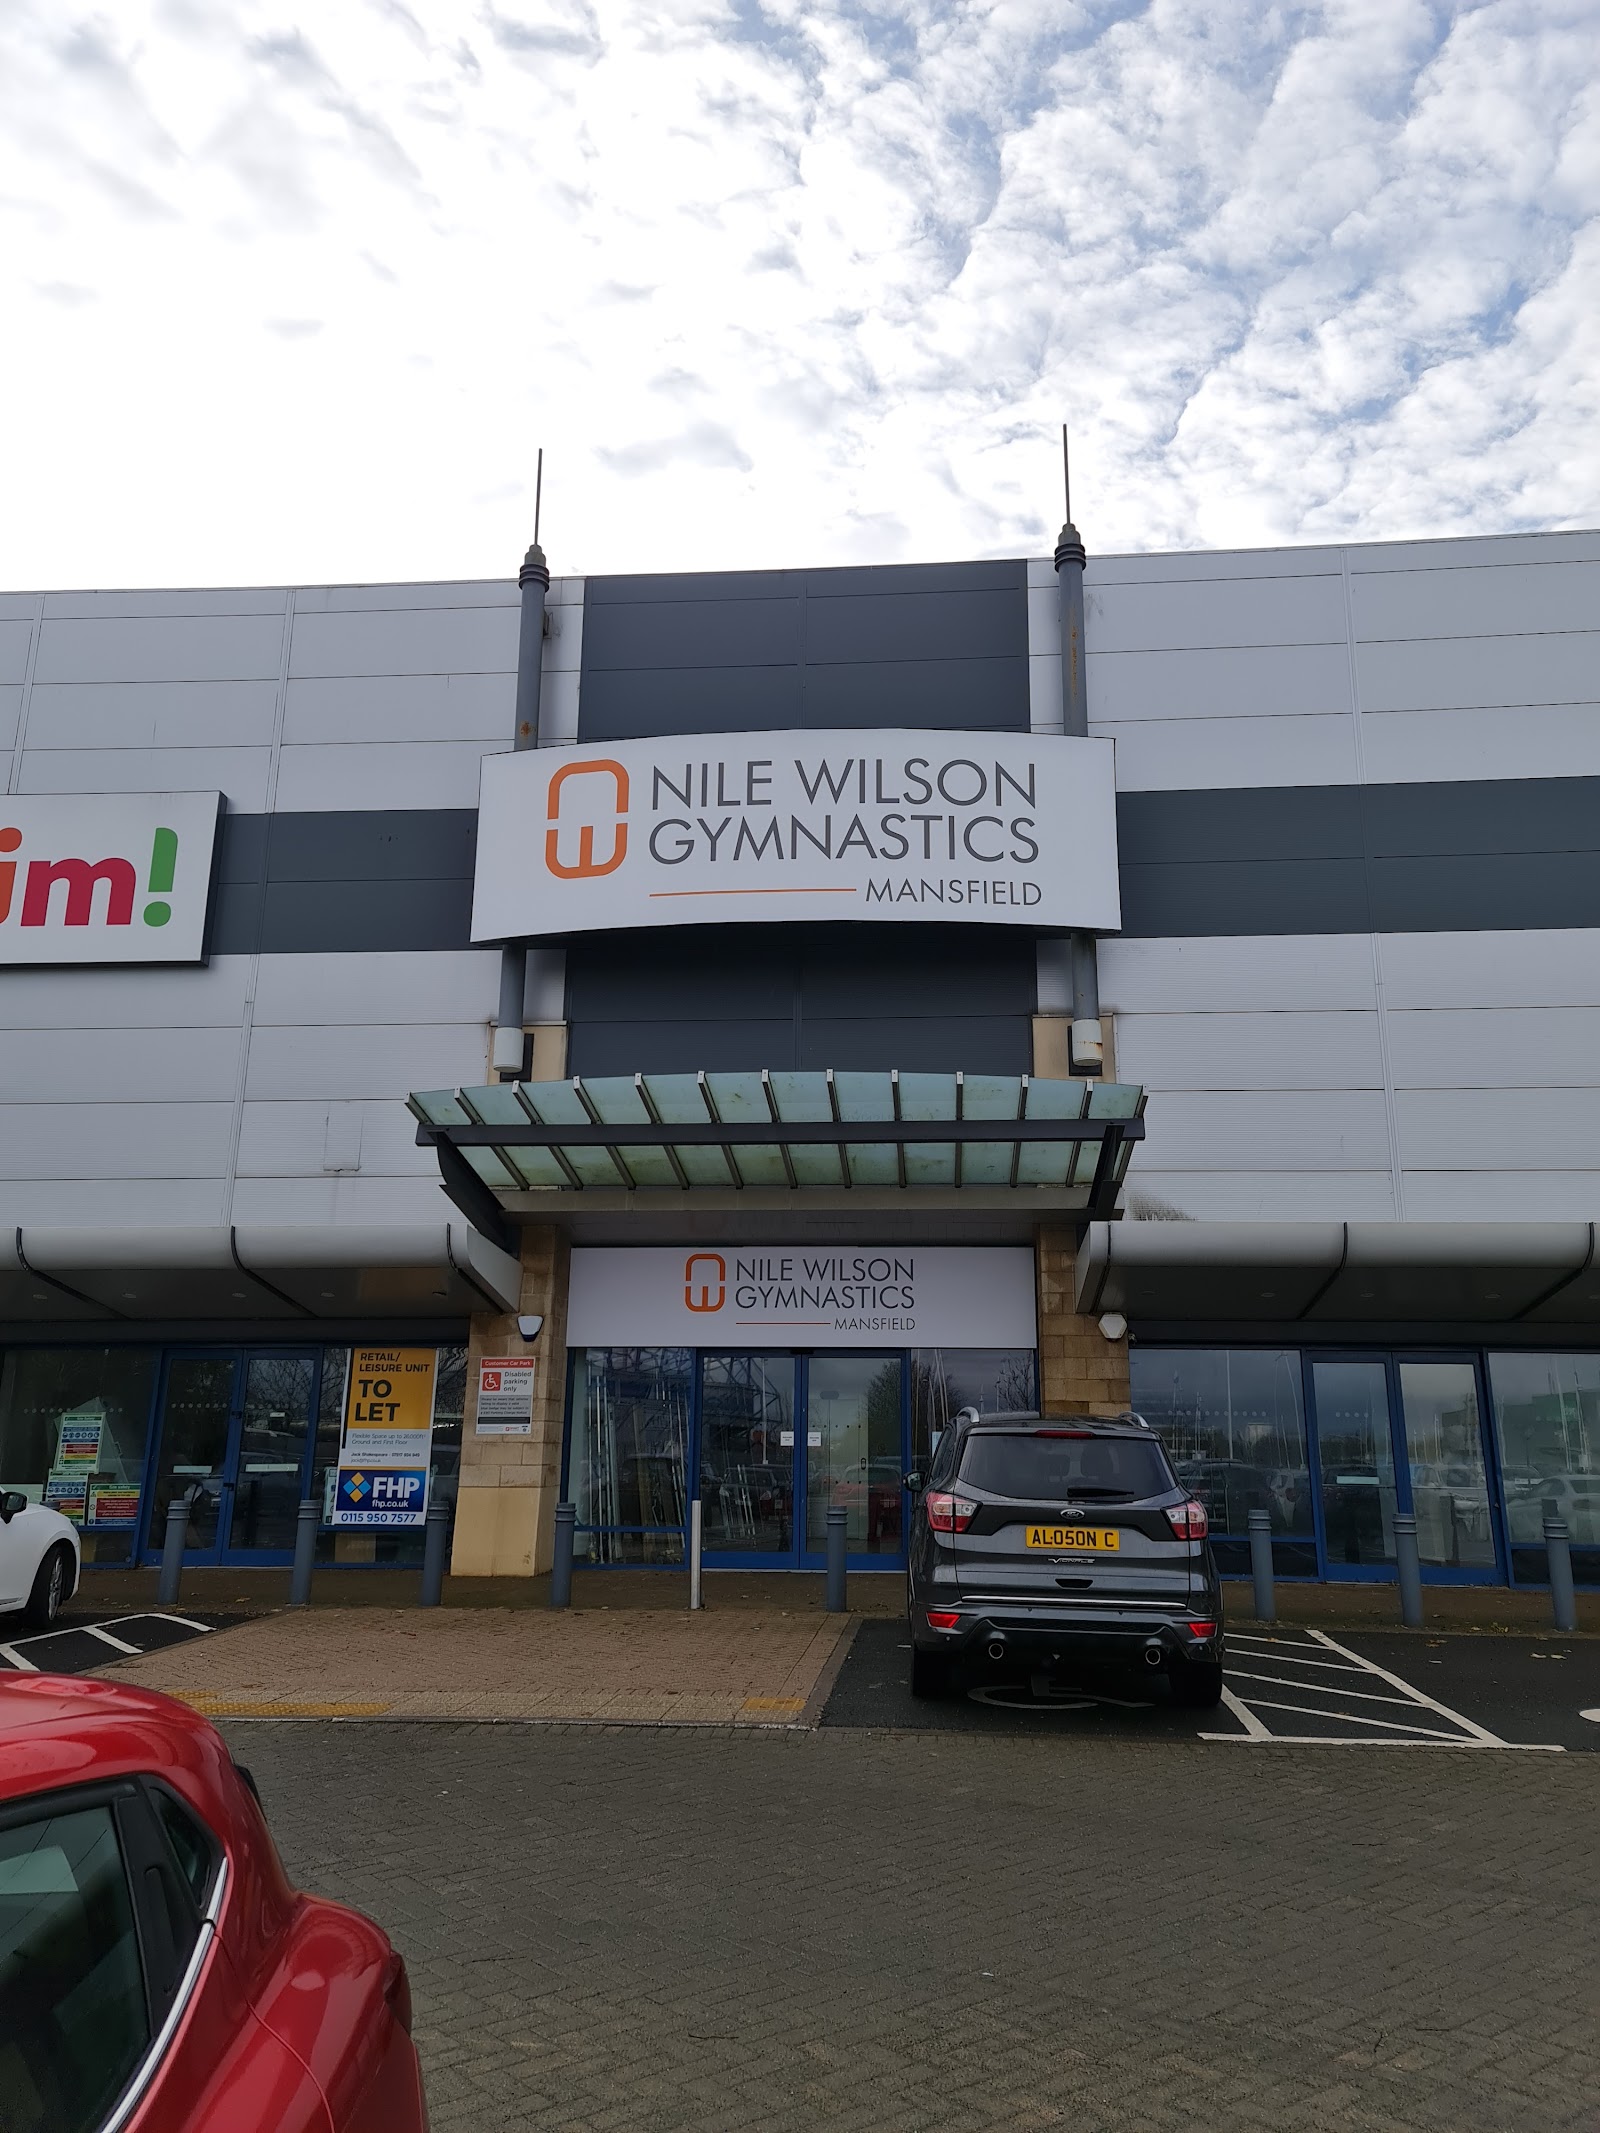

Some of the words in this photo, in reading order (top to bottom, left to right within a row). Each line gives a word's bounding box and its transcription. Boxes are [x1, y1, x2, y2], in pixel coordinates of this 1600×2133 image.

[652, 760, 773, 811] NILE
[794, 757, 1037, 809] WILSON
[648, 813, 1040, 865] GYMNASTICS
[865, 878, 1043, 907] MANSFIELD
[736, 1258, 793, 1281] NILE
[802, 1258, 914, 1282] WILSON
[735, 1285, 915, 1309] GYMNASTICS
[834, 1317, 916, 1331] MANSFIELD
[360, 1352, 401, 1362] RETAIL/
[359, 1363, 402, 1372] LEISURE
[405, 1364, 430, 1372] UNIT
[358, 1379, 392, 1398] TO
[354, 1402, 401, 1421] LET
[372, 1477, 420, 1498] FHP
[372, 1500, 408, 1508] fhp.co.uk
[341, 1513, 364, 1522] 0115
[366, 1513, 388, 1522] 950
[391, 1514, 416, 1523] 7577
